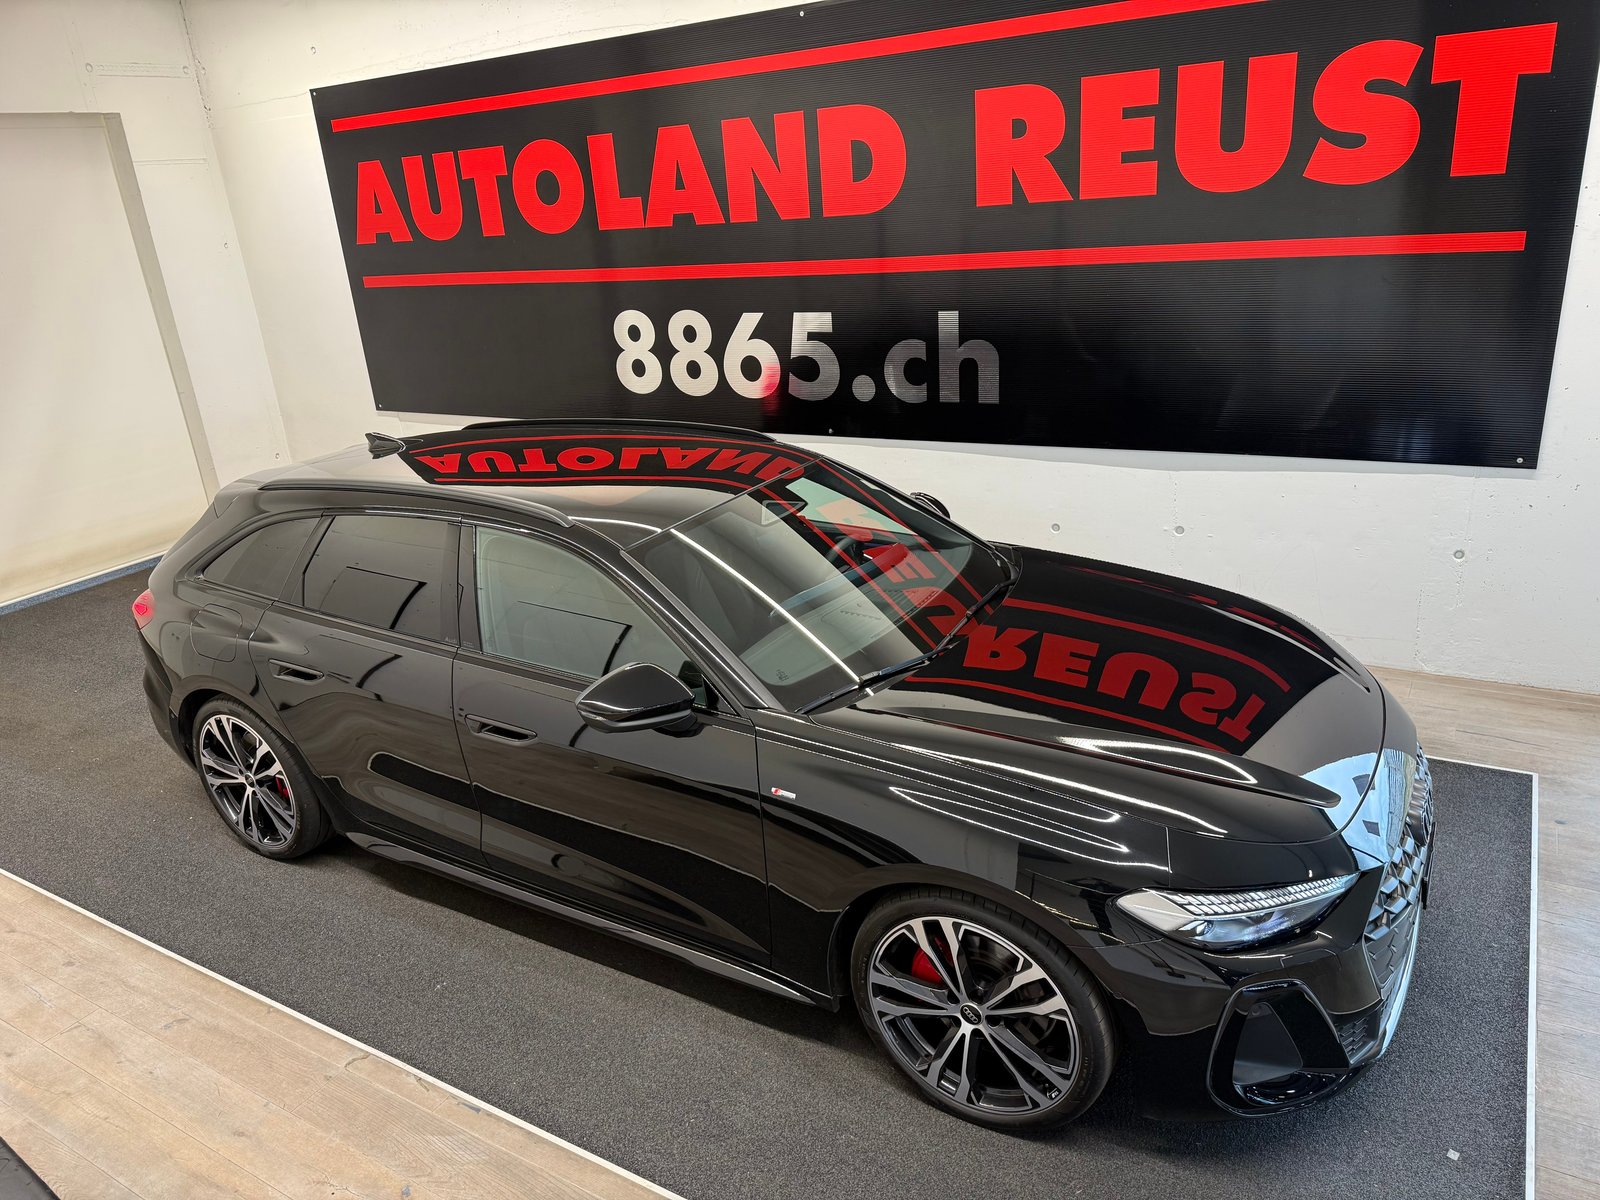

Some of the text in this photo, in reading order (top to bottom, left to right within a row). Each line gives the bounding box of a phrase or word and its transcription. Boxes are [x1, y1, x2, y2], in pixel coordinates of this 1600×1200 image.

[356, 22, 1558, 246] AUTOLAND REUST
[613, 309, 1000, 405] 8865.ch
